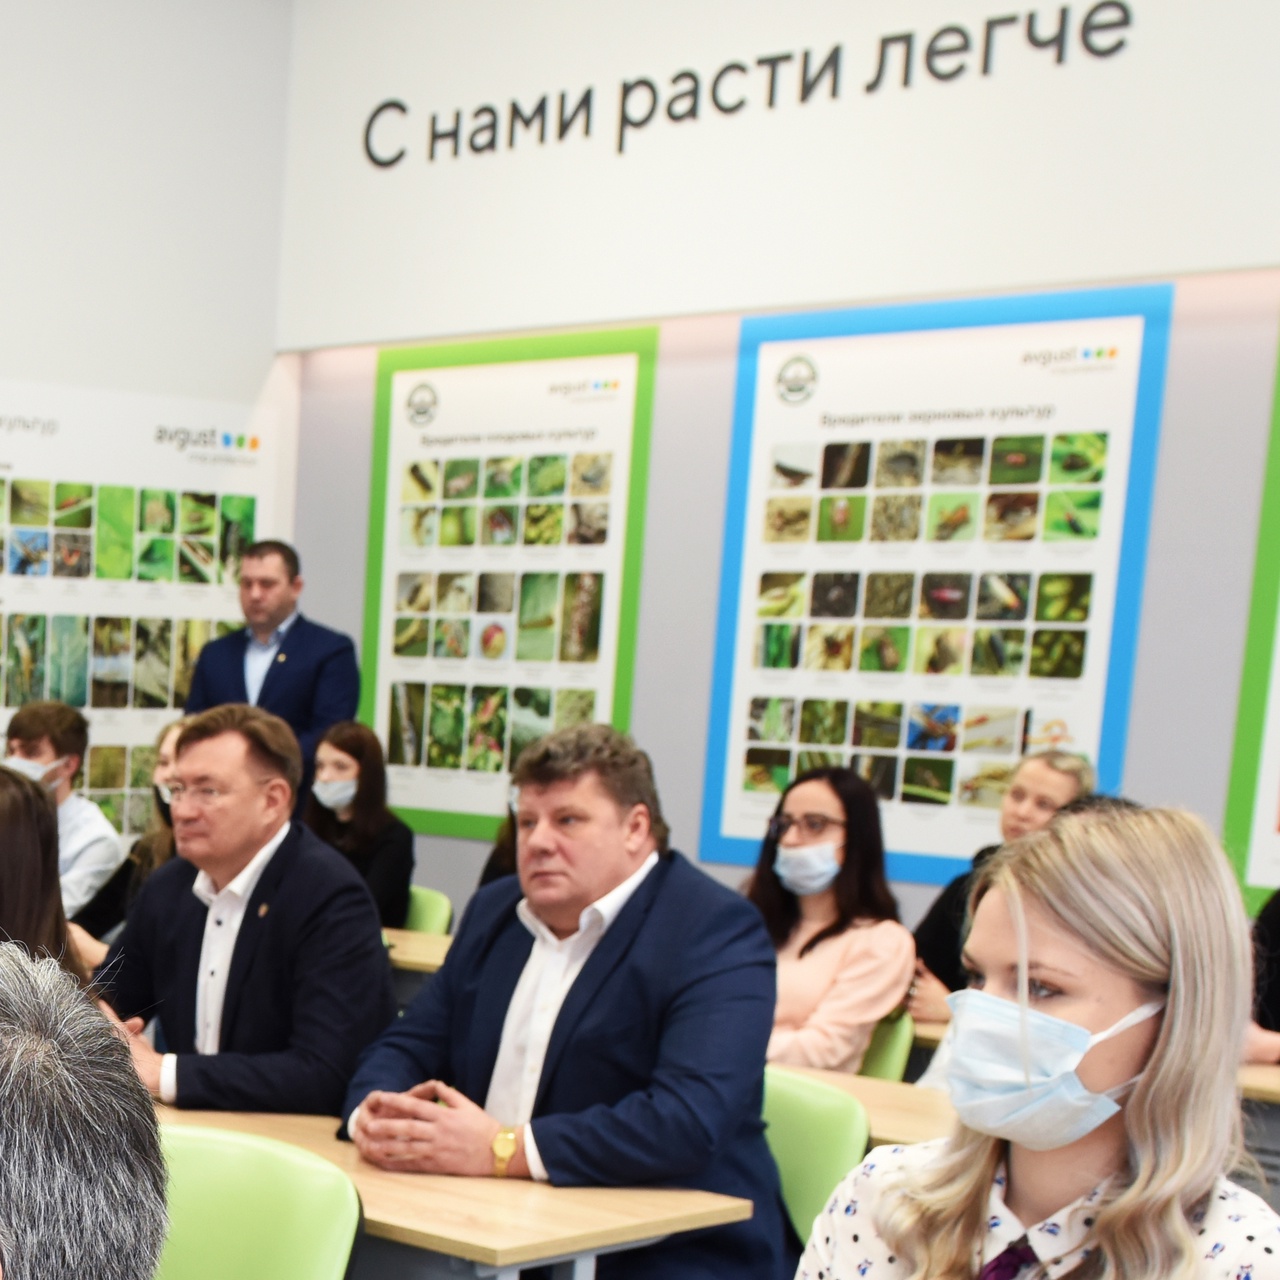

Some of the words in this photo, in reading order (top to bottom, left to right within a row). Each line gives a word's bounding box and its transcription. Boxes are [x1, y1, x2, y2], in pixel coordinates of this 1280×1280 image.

[362, 99, 408, 170] С
[427, 87, 594, 162] нами
[616, 44, 843, 155] расти
[865, 0, 1133, 95] легче
[154, 425, 217, 452] avgust
